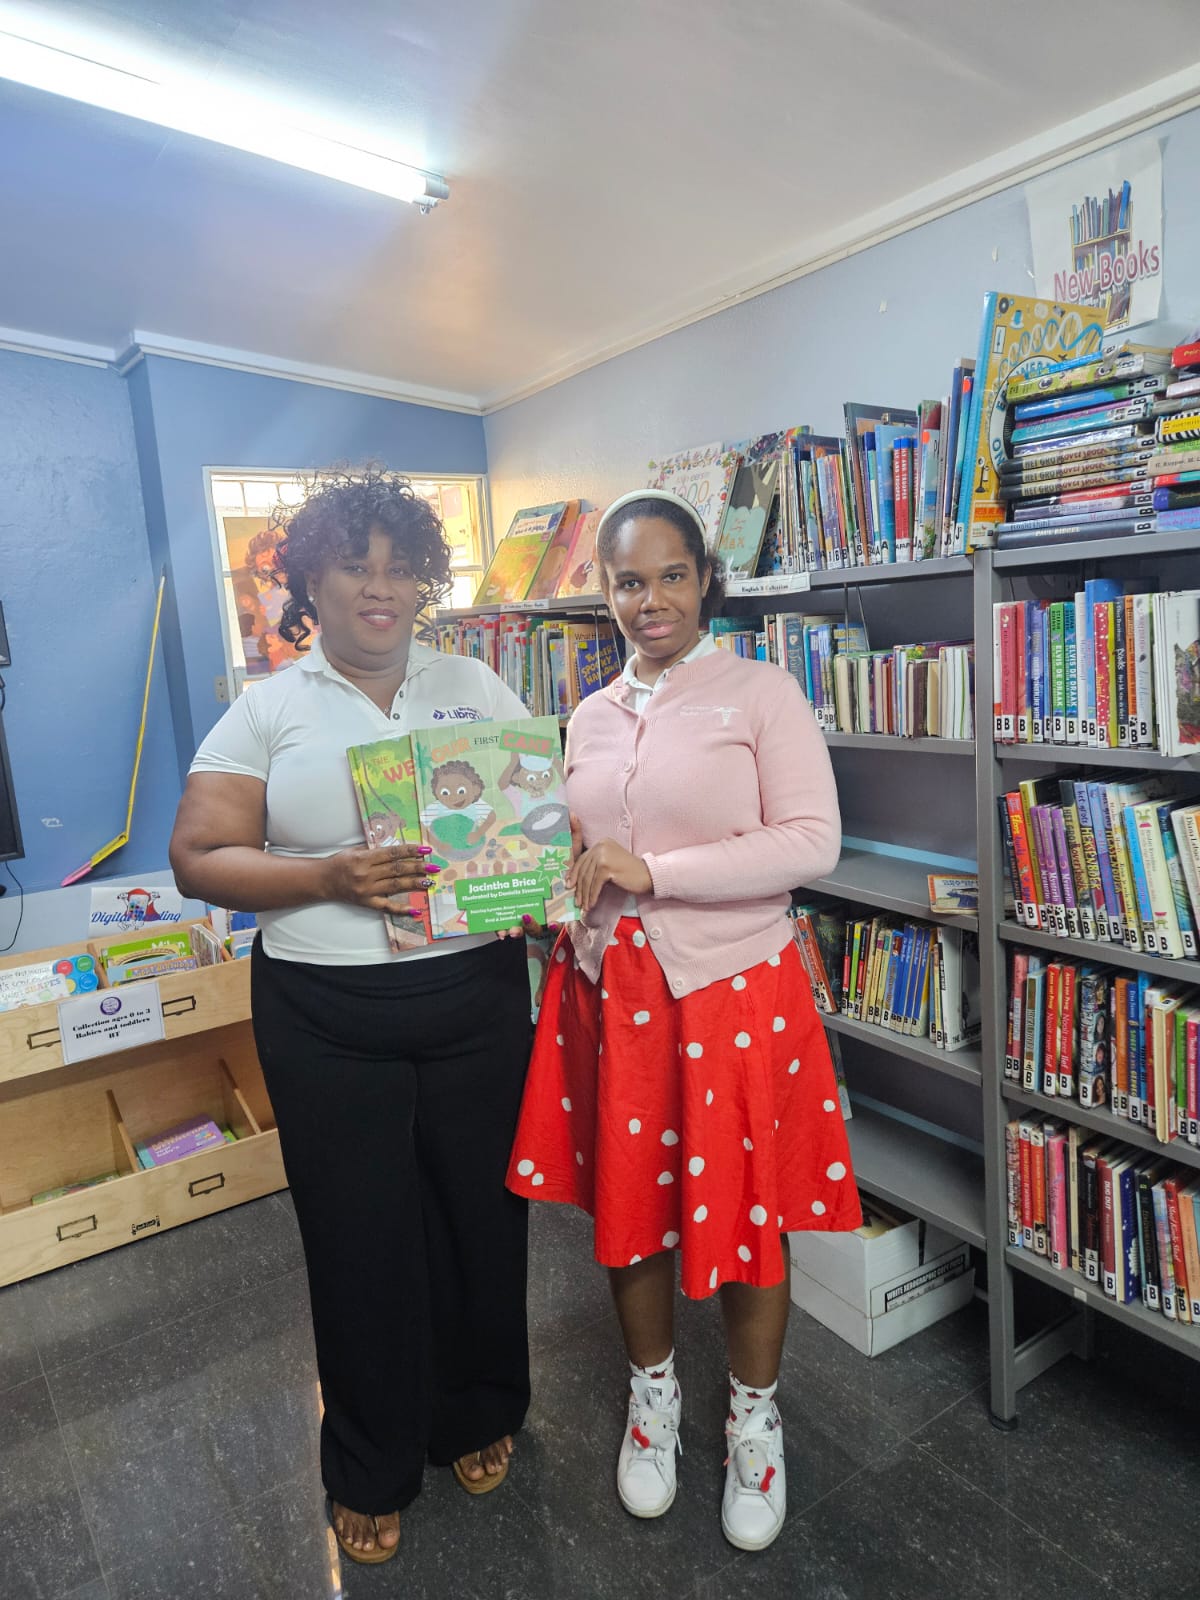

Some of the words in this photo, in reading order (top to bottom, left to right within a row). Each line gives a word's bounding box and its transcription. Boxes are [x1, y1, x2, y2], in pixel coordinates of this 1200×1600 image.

[1054, 261, 1095, 302] New
[1099, 242, 1160, 292] Books
[1144, 380, 1158, 388] B
[1056, 668, 1062, 678] DE
[1070, 668, 1076, 678] DE
[818, 710, 822, 720] B
[1005, 718, 1009, 730] B
[1020, 719, 1025, 731] B
[1034, 722, 1039, 734] B
[1056, 719, 1061, 731] B
[1069, 722, 1074, 734] B
[1082, 720, 1087, 733] B
[1089, 722, 1095, 735] B
[1141, 722, 1147, 735] B
[1100, 728, 1105, 741] B
[1120, 726, 1126, 739] B
[1131, 730, 1137, 742] B
[474, 736, 499, 745] FIRST
[503, 733, 550, 754] CAKE
[431, 737, 472, 763] OUR
[469, 880, 510, 894] Jacintha
[512, 878, 536, 887] Brice
[1018, 902, 1023, 914] B
[1028, 907, 1034, 918] B
[91, 911, 130, 926] Digital
[1041, 910, 1047, 922] B
[1050, 916, 1056, 928] B
[1057, 917, 1064, 929] B
[1069, 921, 1075, 933] B
[1084, 922, 1090, 934] B
[1113, 922, 1120, 934] B
[1100, 924, 1106, 936] B
[1130, 930, 1137, 943] B
[1148, 935, 1155, 948] B
[1184, 935, 1192, 947] B
[1161, 937, 1168, 950] B
[869, 1006, 873, 1015] B
[875, 1007, 879, 1016] B
[884, 1011, 888, 1021] B
[73, 1020, 110, 1031] Collection
[76, 1030, 102, 1039] Babies
[120, 1018, 150, 1028] toddlers
[937, 1031, 942, 1041] B
[1007, 1058, 1012, 1069] B
[1014, 1059, 1019, 1070] B
[1026, 1072, 1032, 1083] B
[1046, 1075, 1052, 1087] B
[1061, 1076, 1067, 1088] B
[1082, 1086, 1088, 1098] B
[1121, 1096, 1127, 1109] B
[1132, 1105, 1138, 1118] B
[1180, 1121, 1187, 1134] B
[1190, 1122, 1197, 1134] B
[1011, 1232, 1015, 1242] B
[1025, 1229, 1030, 1240] B
[1038, 1237, 1043, 1248] B
[1054, 1252, 1058, 1263] B
[1089, 1265, 1095, 1276] B
[1108, 1278, 1113, 1289] B
[886, 1288, 903, 1300] WHITE
[1150, 1288, 1156, 1299] B
[1165, 1298, 1171, 1310] B
[1180, 1299, 1186, 1311] B
